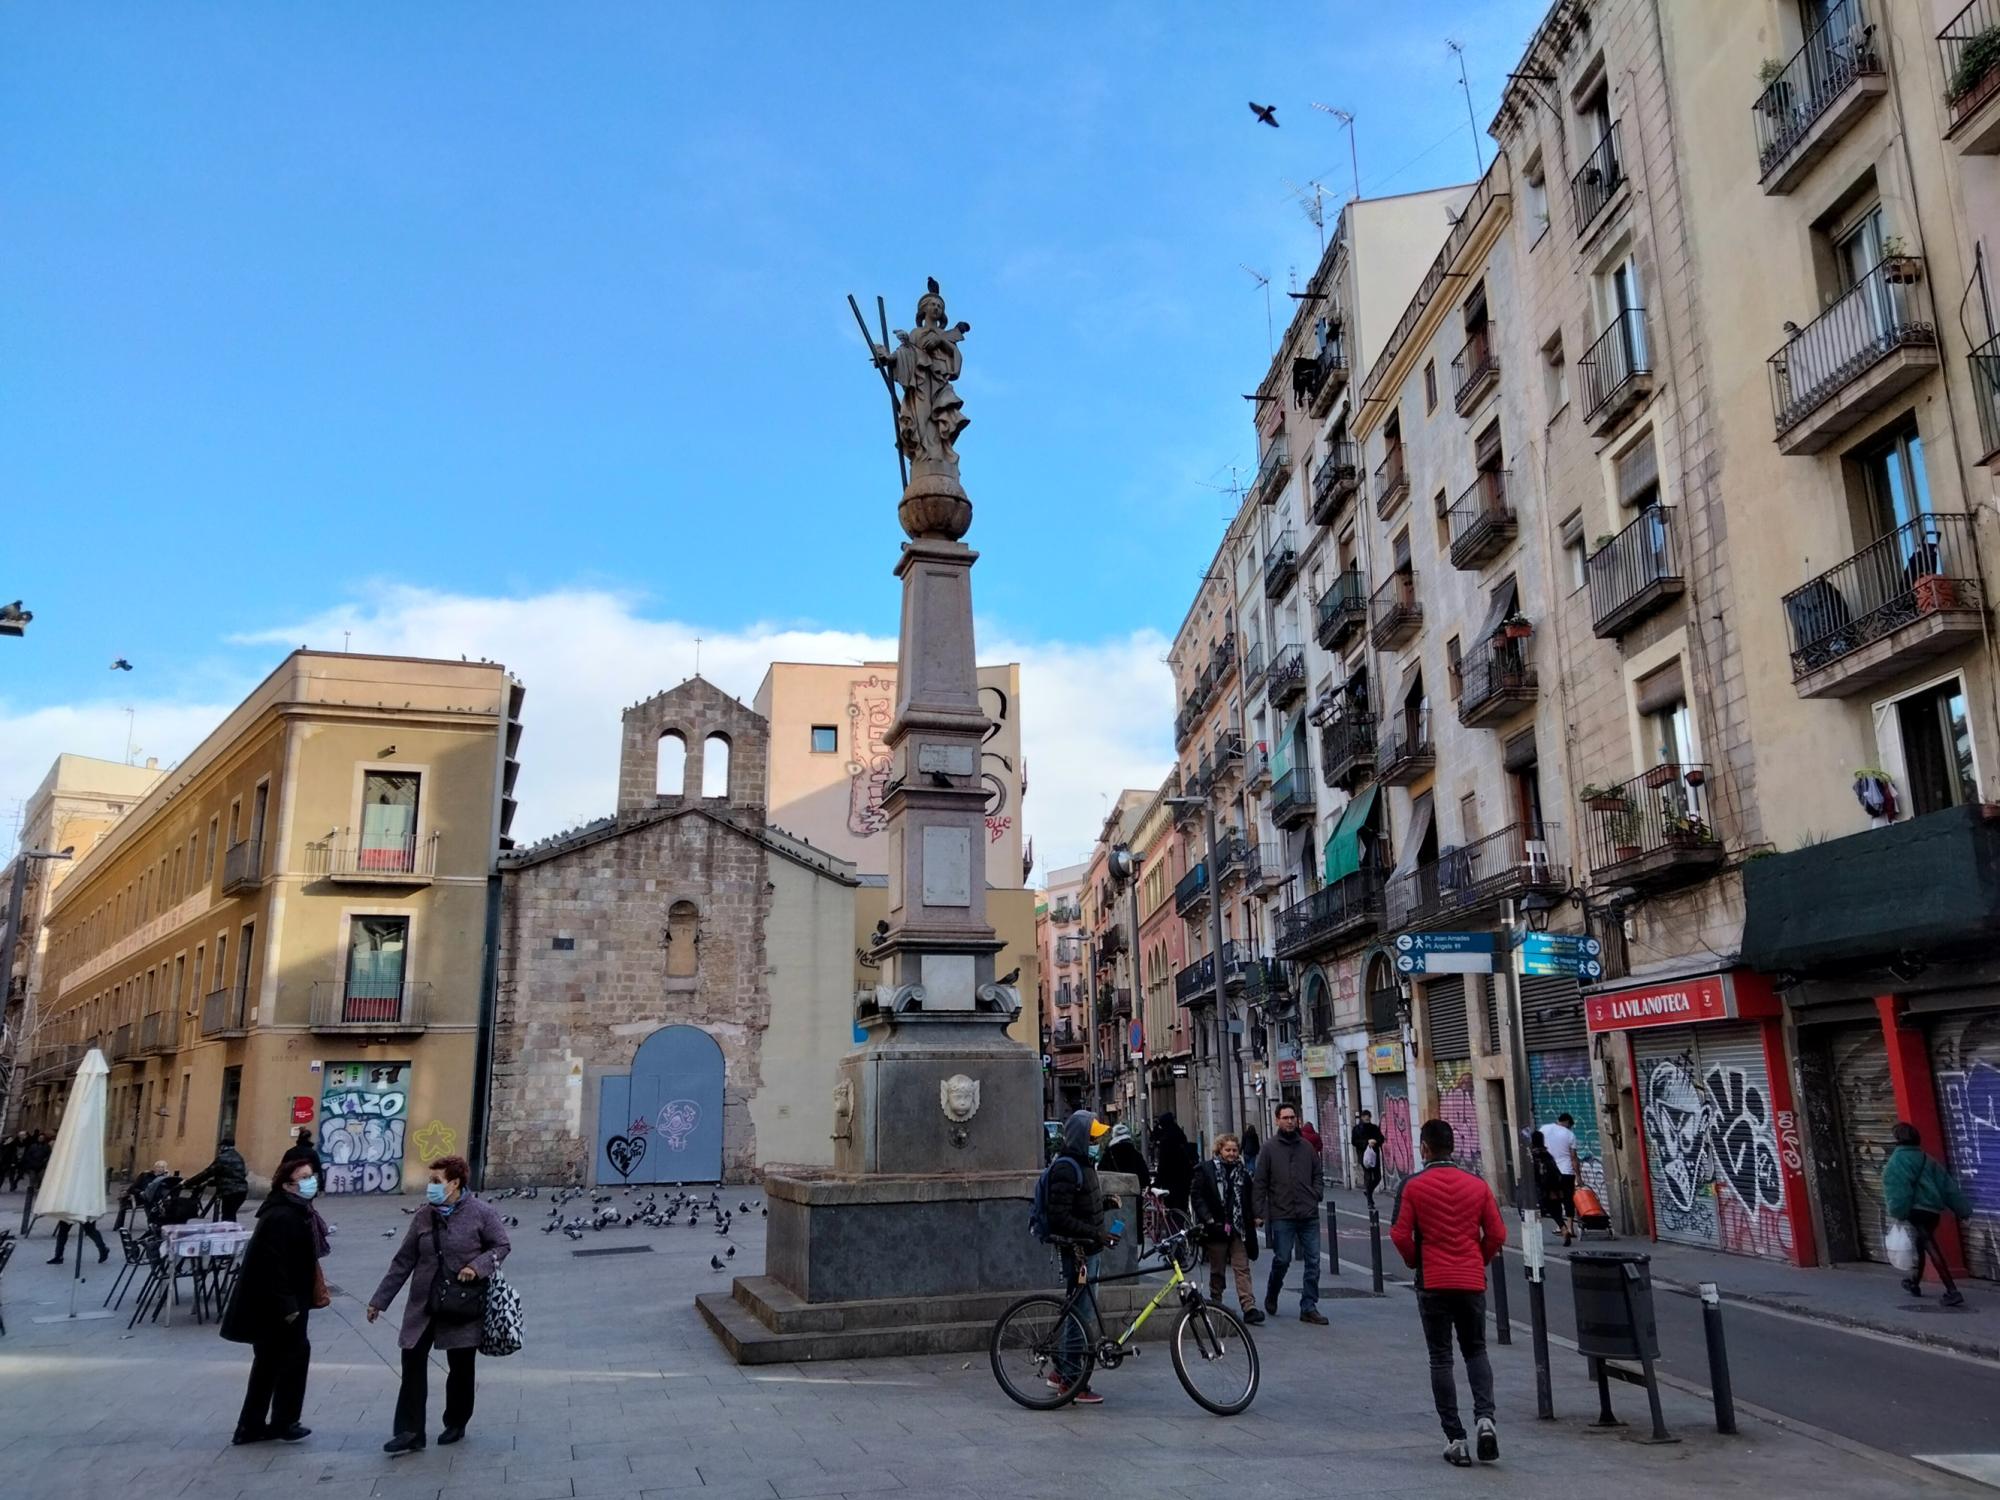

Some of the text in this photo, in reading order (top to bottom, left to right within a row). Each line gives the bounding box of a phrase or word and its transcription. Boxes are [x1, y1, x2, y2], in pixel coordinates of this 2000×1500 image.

[1612, 1002, 1626, 1019] LA
[1626, 992, 1690, 1017] VILANOTECA
[1042, 1054, 1051, 1067] P
